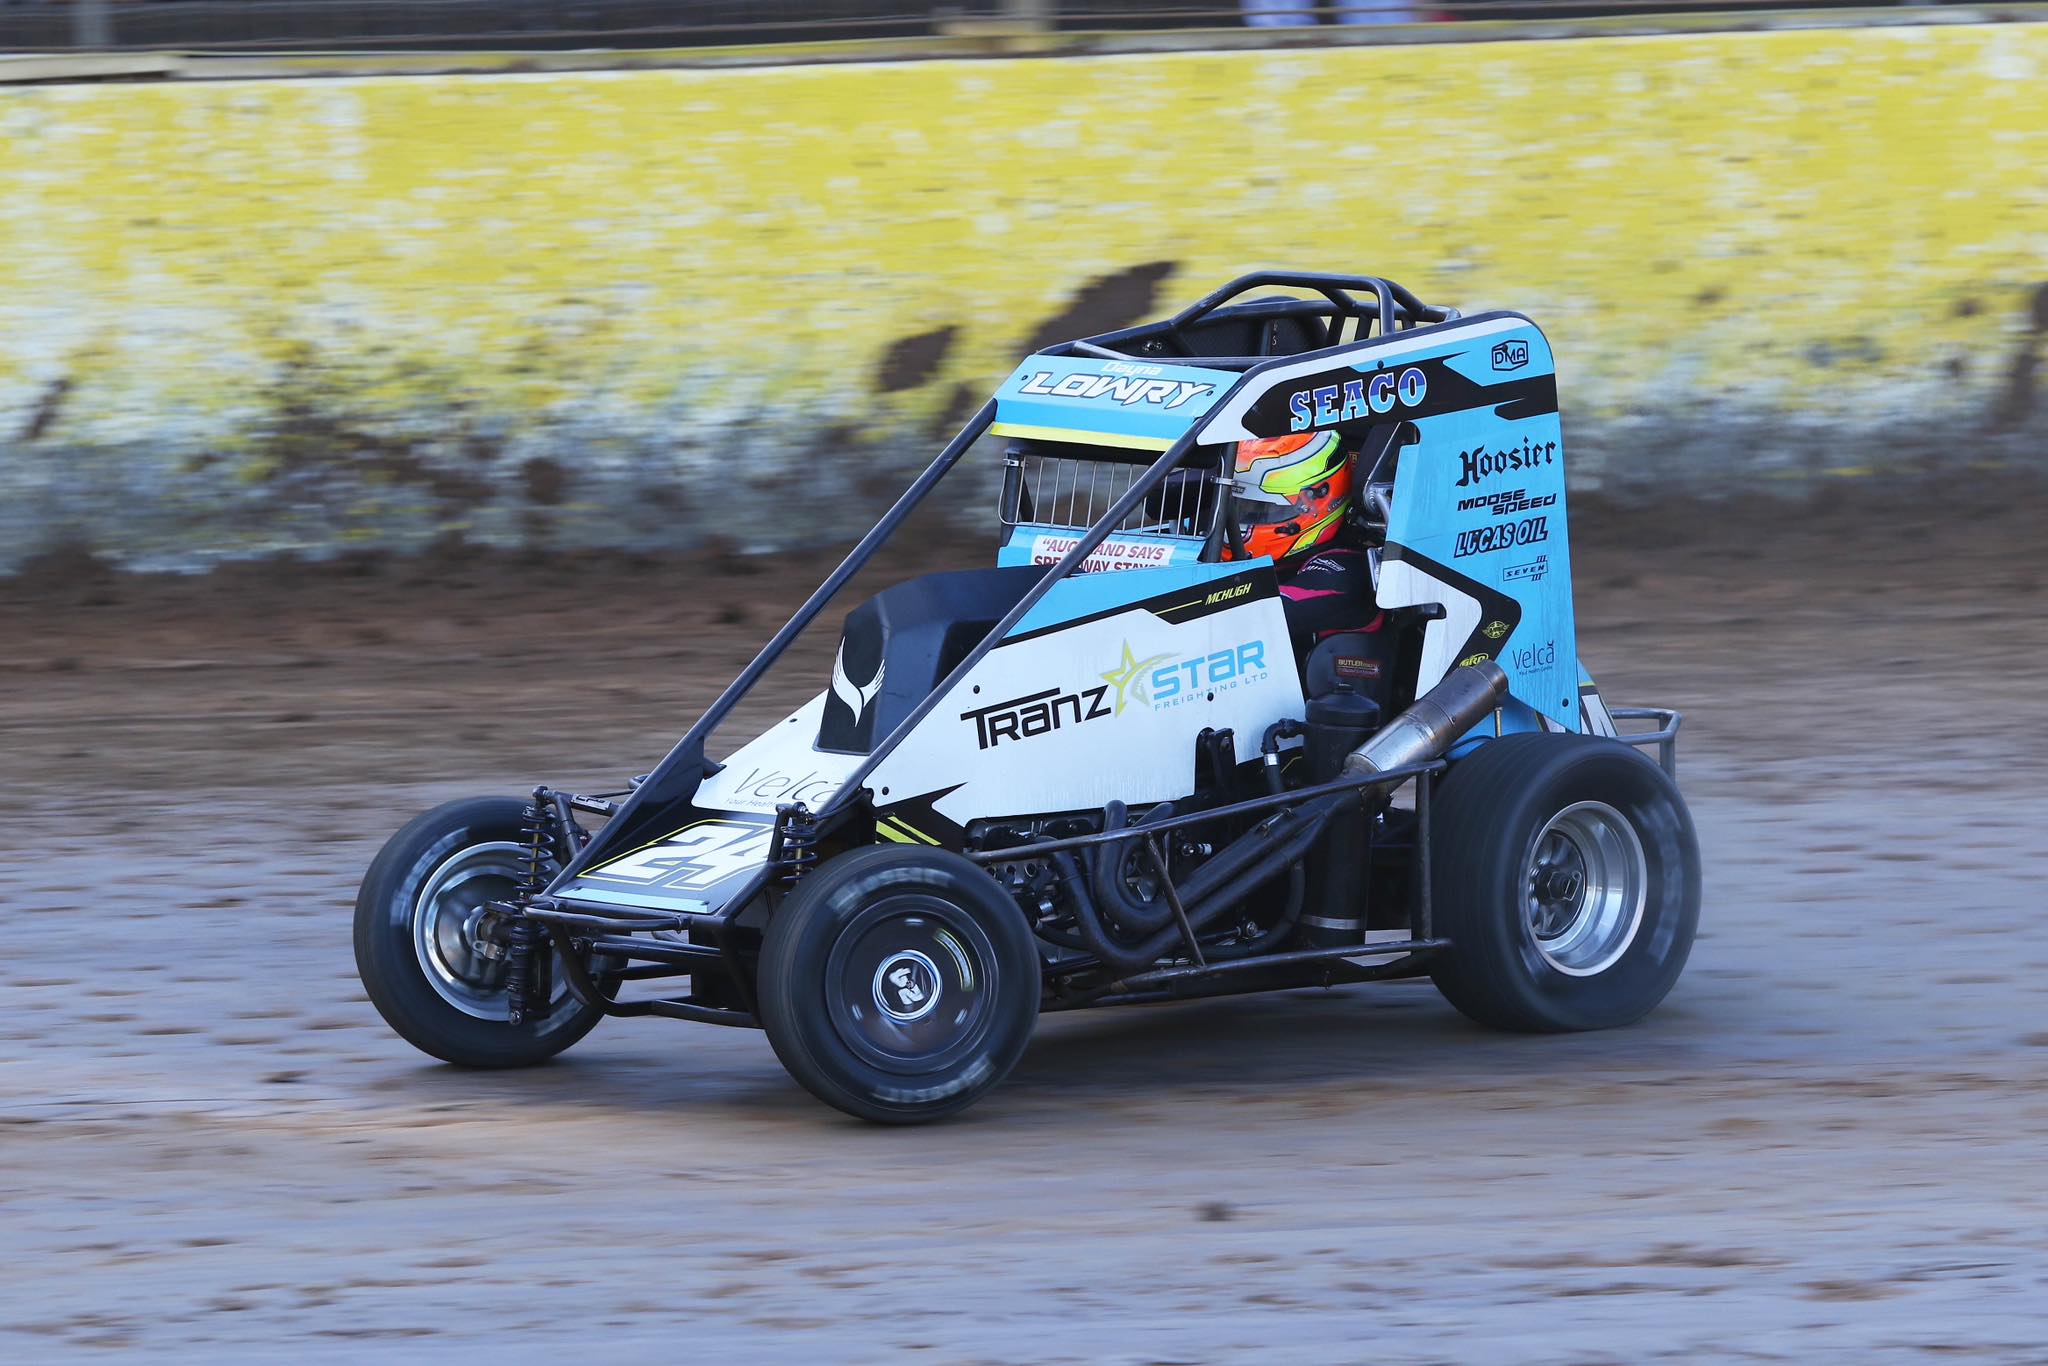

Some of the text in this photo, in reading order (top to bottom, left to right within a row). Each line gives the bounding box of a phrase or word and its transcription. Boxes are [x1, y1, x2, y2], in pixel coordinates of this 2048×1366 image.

[1494, 347, 1526, 365] DMA
[1018, 371, 1217, 410] LOWRY
[1289, 367, 1427, 432] SEACO
[1455, 435, 1556, 487] Hoosier
[1457, 488, 1526, 511] MOOSE
[1127, 545, 1166, 560] SAYS
[1454, 516, 1548, 558] LUCAS OIL
[1505, 564, 1545, 578] SEVEN
[1205, 582, 1252, 605] MCHUGH
[1154, 672, 1268, 712] FREIGHTING LTD
